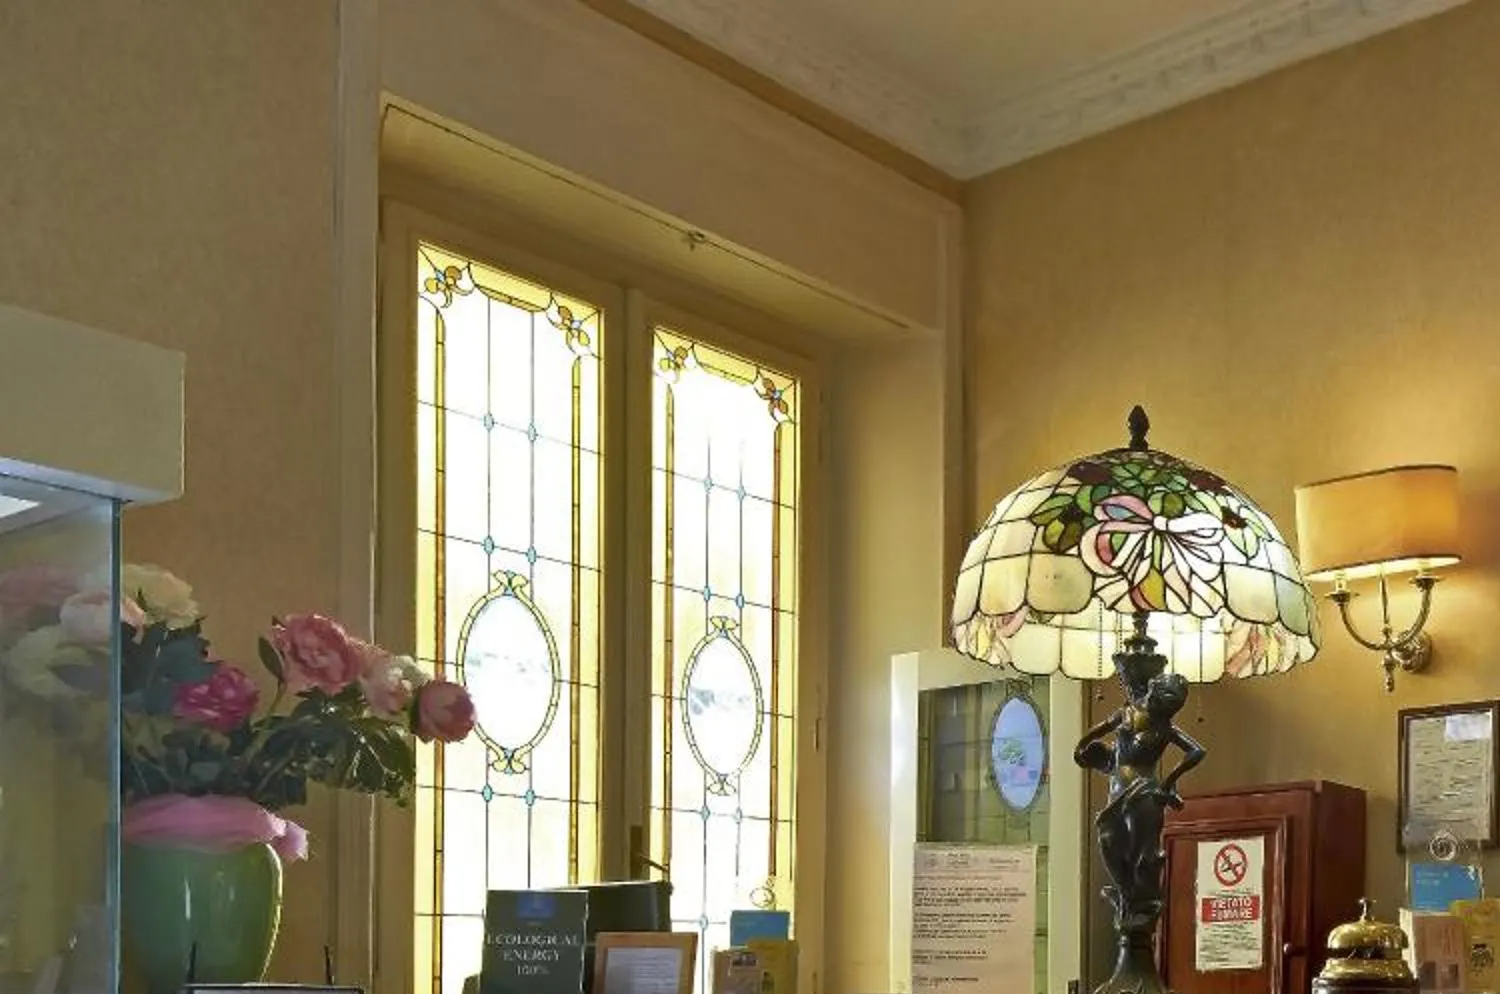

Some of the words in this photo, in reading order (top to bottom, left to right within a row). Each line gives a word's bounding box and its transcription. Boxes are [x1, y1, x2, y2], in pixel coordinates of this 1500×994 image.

[1210, 896, 1252, 908] VETATO
[486, 933, 579, 946] ECOLOGICAL
[503, 948, 560, 961] ENERGY
